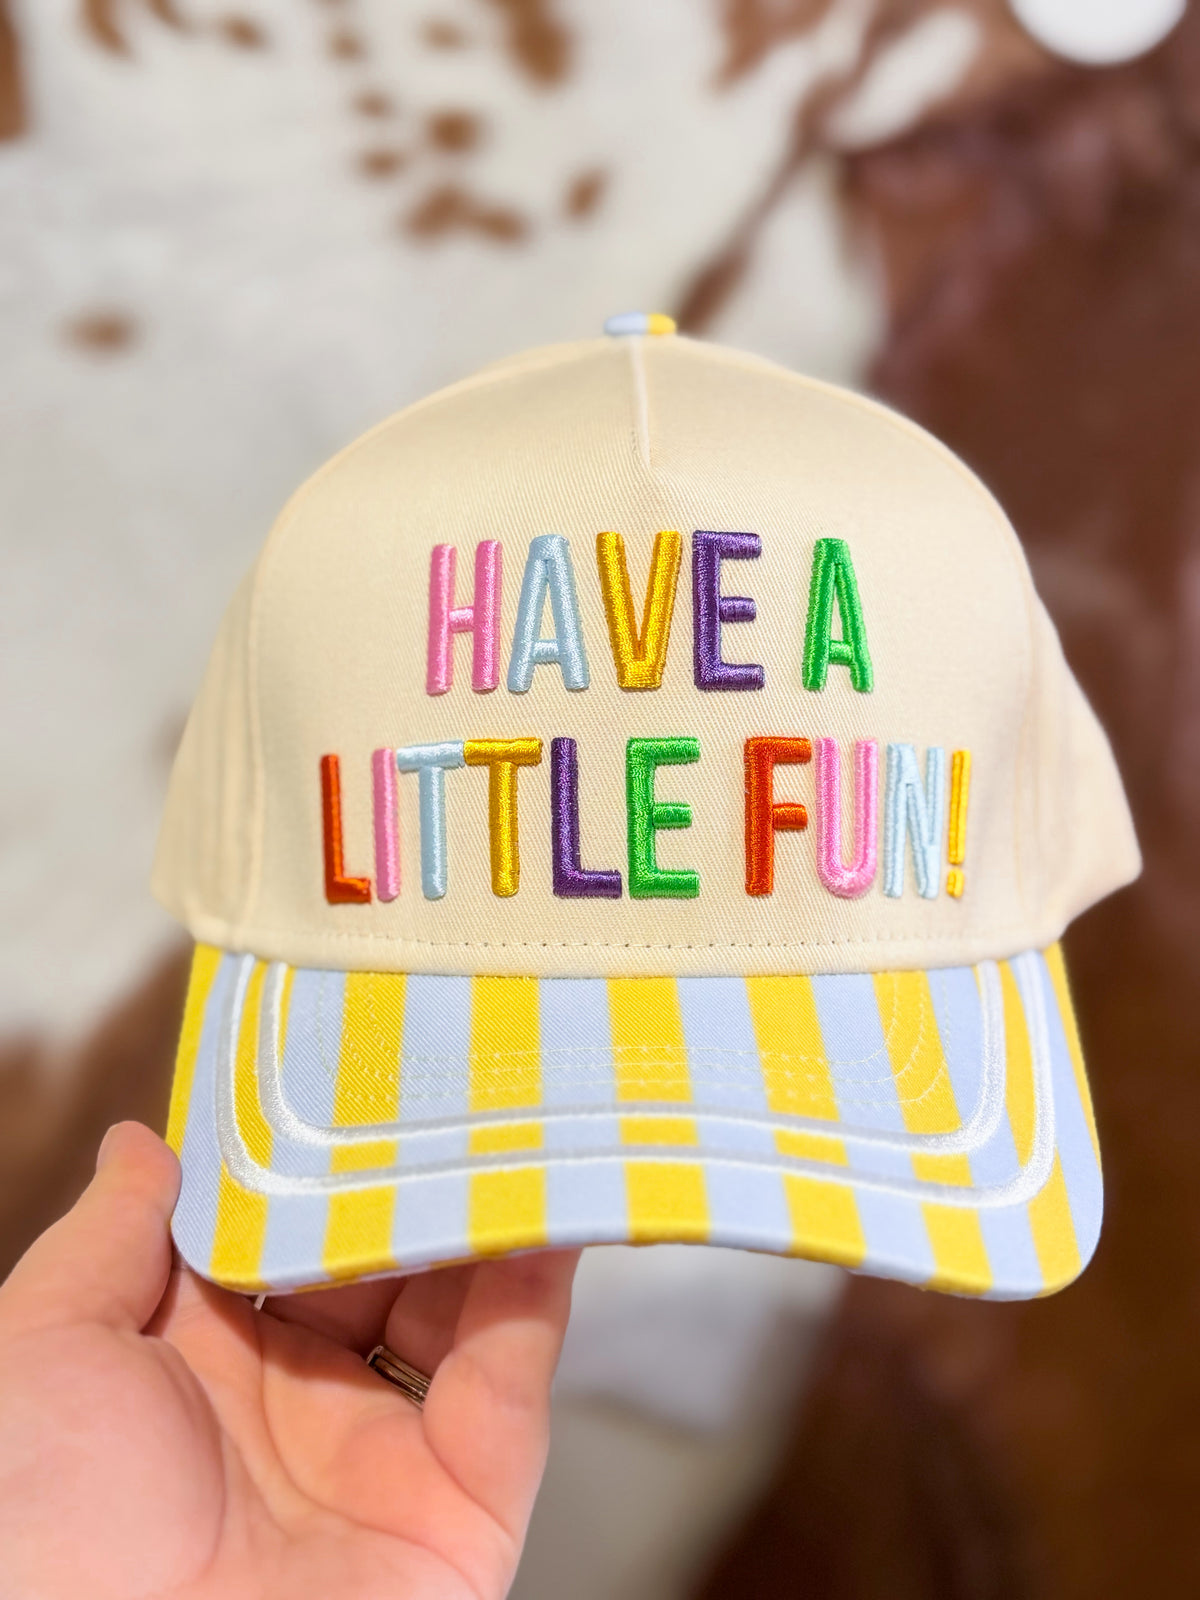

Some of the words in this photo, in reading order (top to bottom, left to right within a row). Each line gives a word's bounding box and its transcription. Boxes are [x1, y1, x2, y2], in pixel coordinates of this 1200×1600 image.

[426, 531, 764, 695] HAVE
[803, 538, 874, 692] A
[321, 737, 701, 904] LITTLE
[744, 737, 970, 899] FUN!
